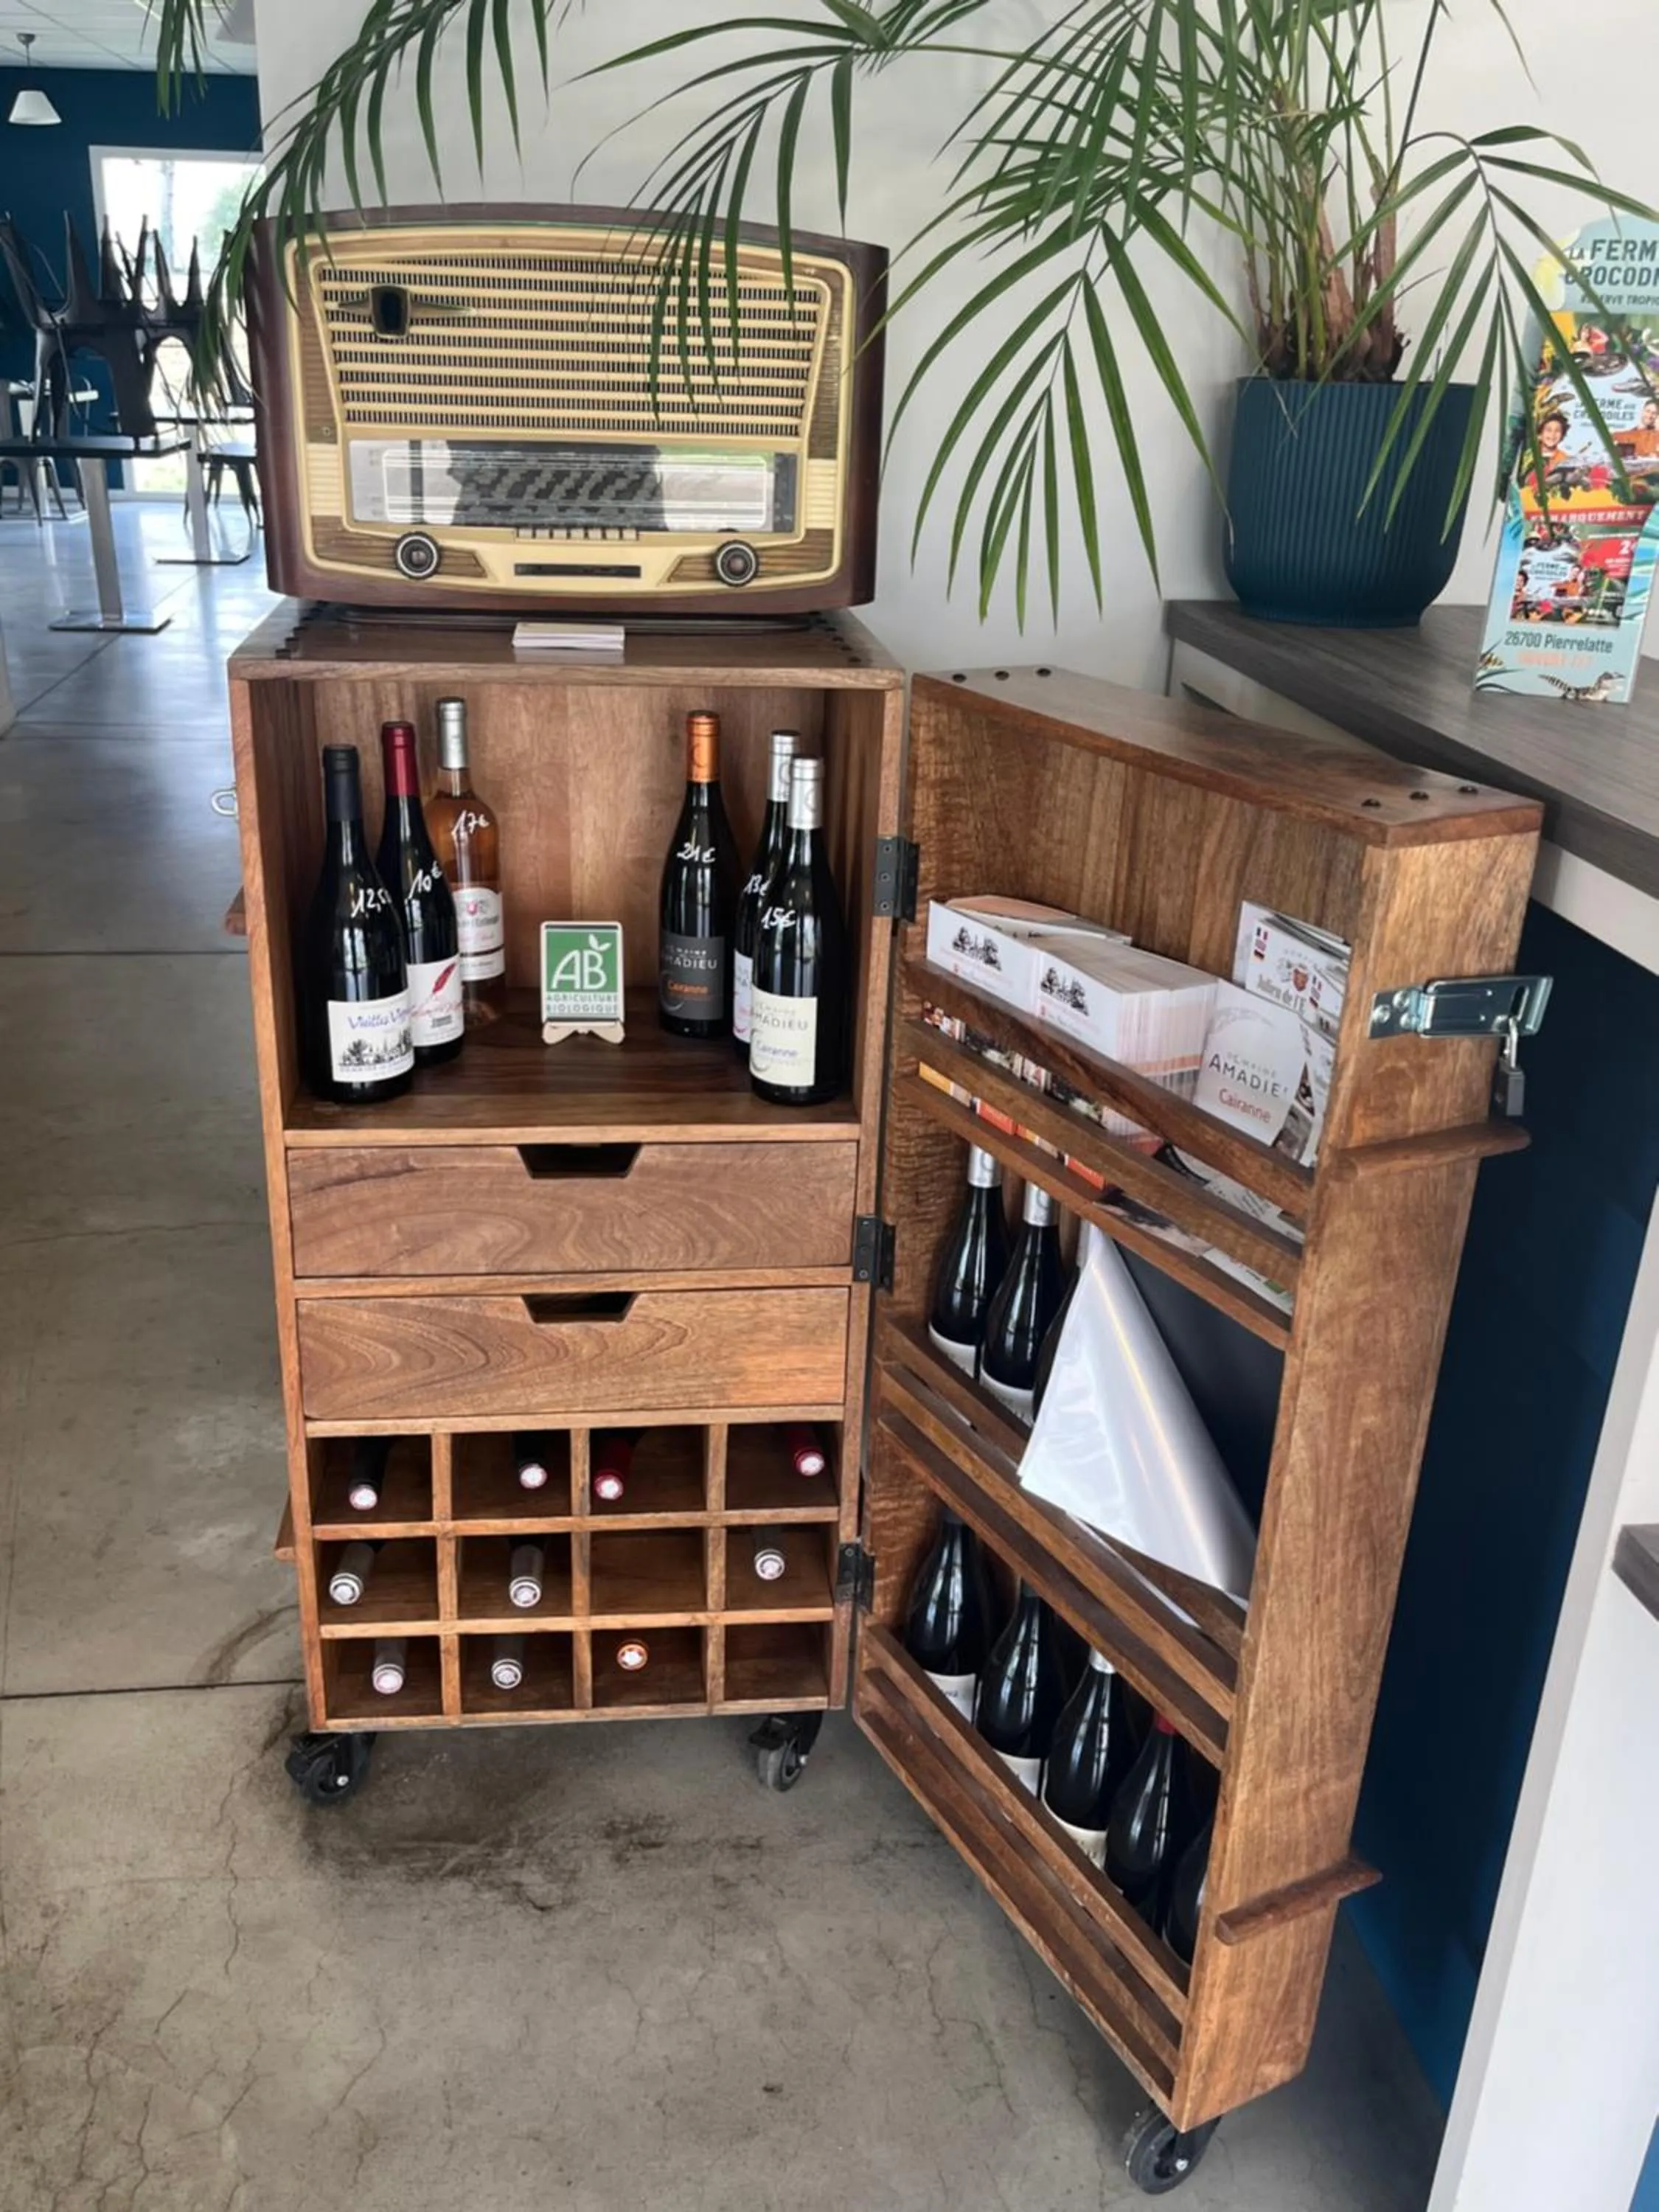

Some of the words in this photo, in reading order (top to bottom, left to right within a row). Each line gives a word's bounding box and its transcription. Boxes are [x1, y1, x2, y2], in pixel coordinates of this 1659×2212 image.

[1504, 630, 1542, 648] 26700
[1544, 633, 1613, 653] Pierrelatte
[551, 949, 607, 990] AB
[1208, 1053, 1288, 1098] AMADIE
[1218, 1088, 1272, 1124] Cairanne
